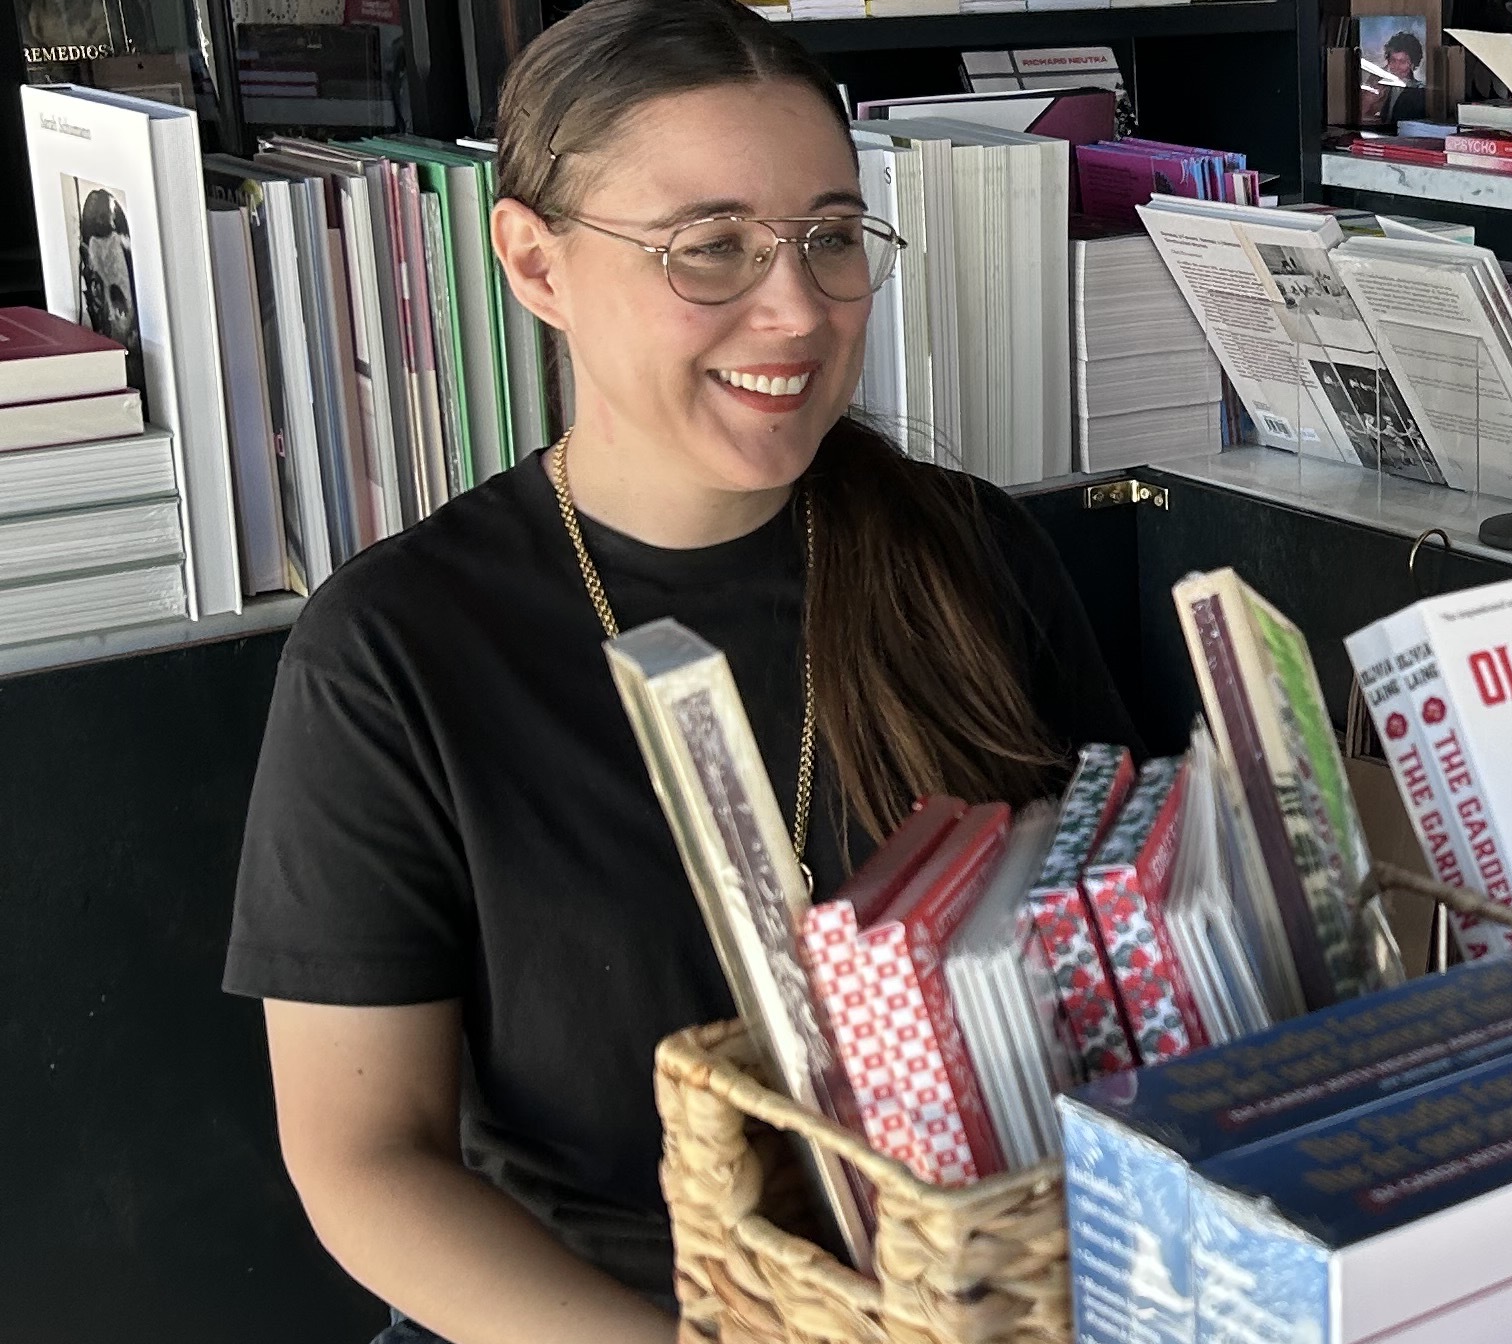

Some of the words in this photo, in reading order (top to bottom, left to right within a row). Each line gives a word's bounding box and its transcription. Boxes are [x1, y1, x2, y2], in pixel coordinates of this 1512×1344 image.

[1022, 56, 1067, 67] RICHARD
[1067, 55, 1108, 66] NEUTRA
[1453, 138, 1498, 155] PSYCHO
[1359, 655, 1395, 687] OLIVIA
[1396, 642, 1435, 671] OLIVIA
[1404, 662, 1440, 692] LAING
[1366, 680, 1402, 707] LAING
[1433, 727, 1470, 793] THE
[1396, 748, 1434, 807] THE
